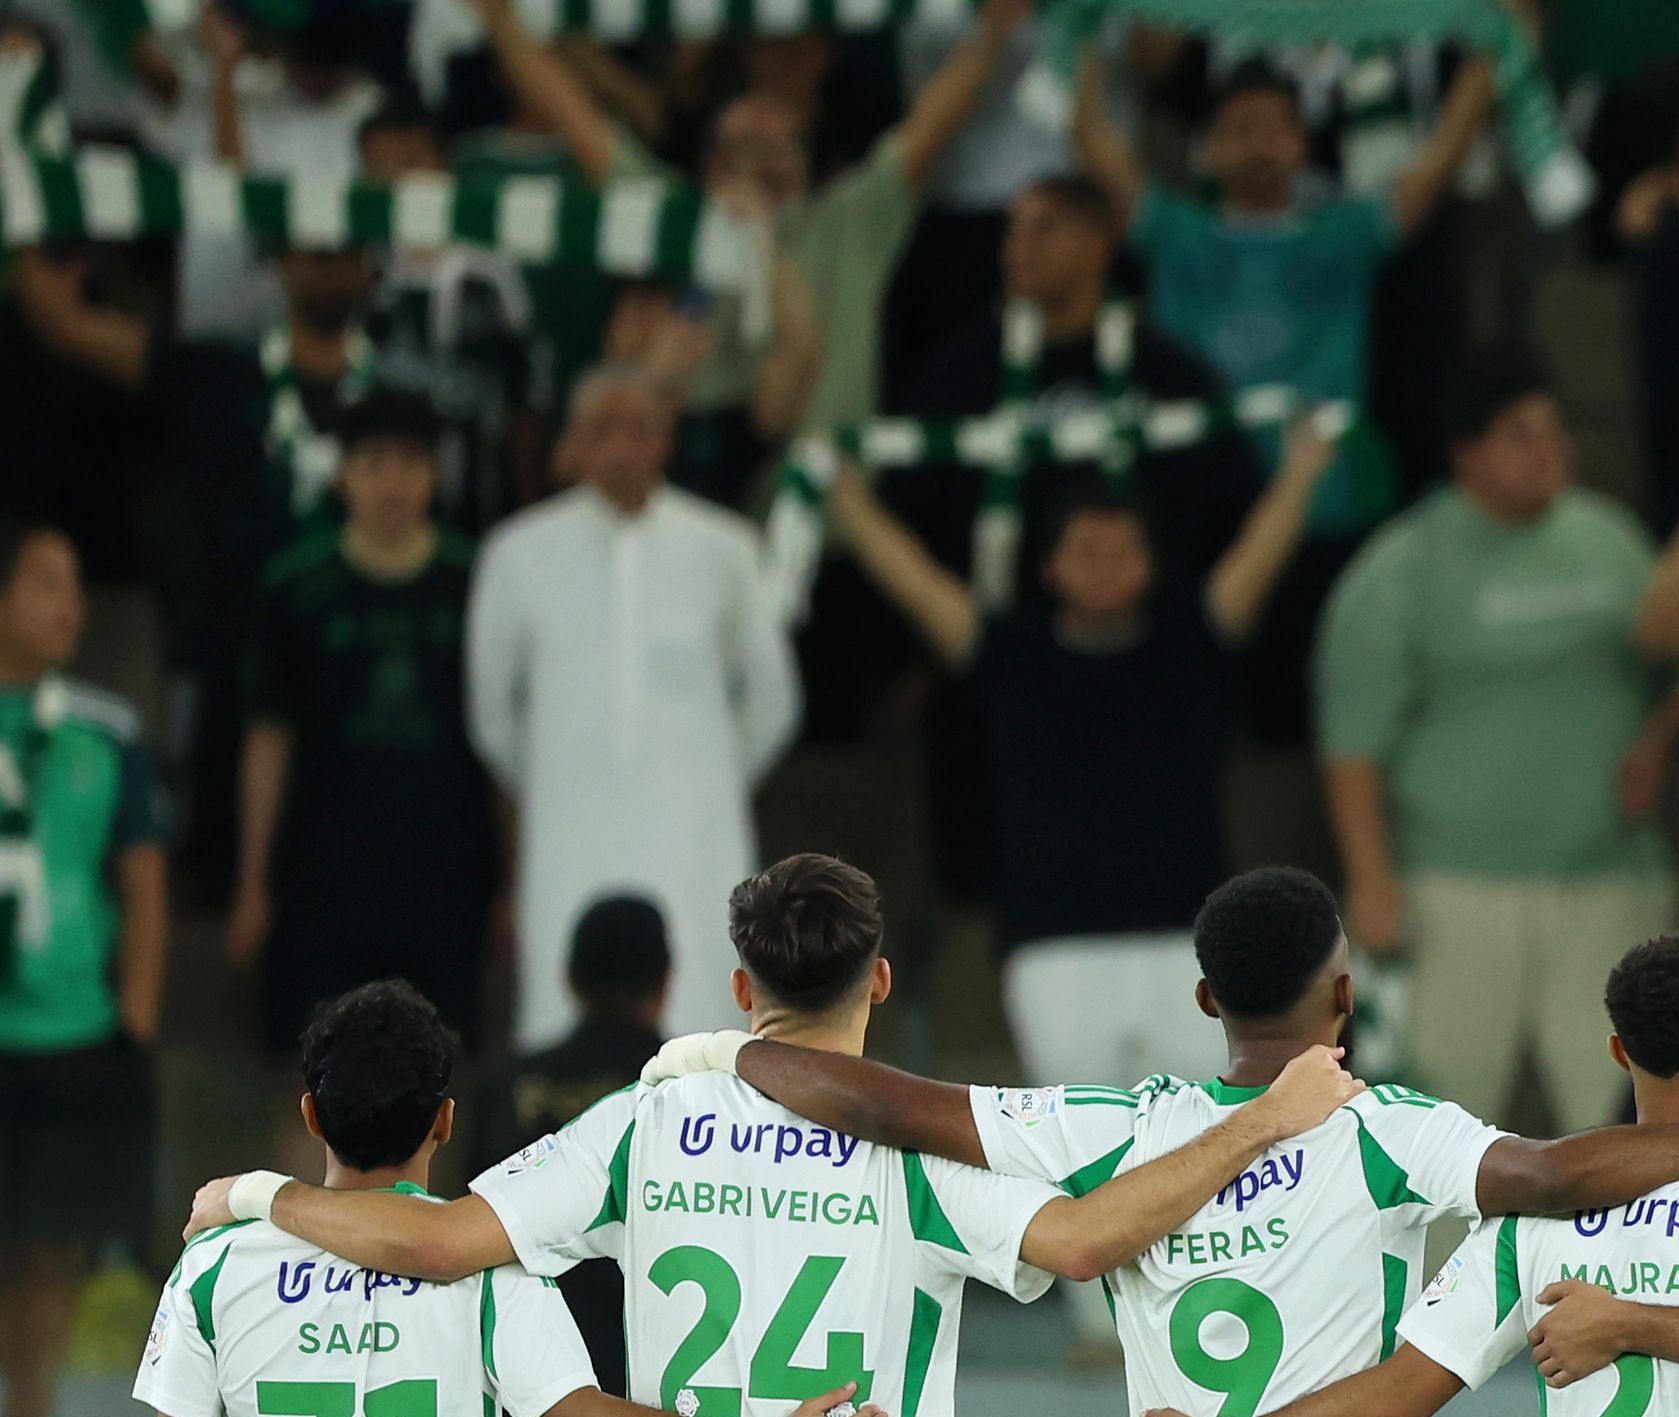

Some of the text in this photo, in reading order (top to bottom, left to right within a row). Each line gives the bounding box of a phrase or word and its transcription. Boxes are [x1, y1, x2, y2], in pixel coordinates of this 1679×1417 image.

[729, 1122, 861, 1168] urpay
[643, 1179, 880, 1226] GABRI VEIGA
[1167, 1217, 1290, 1265] FERAS
[298, 1320, 400, 1355] SAAD
